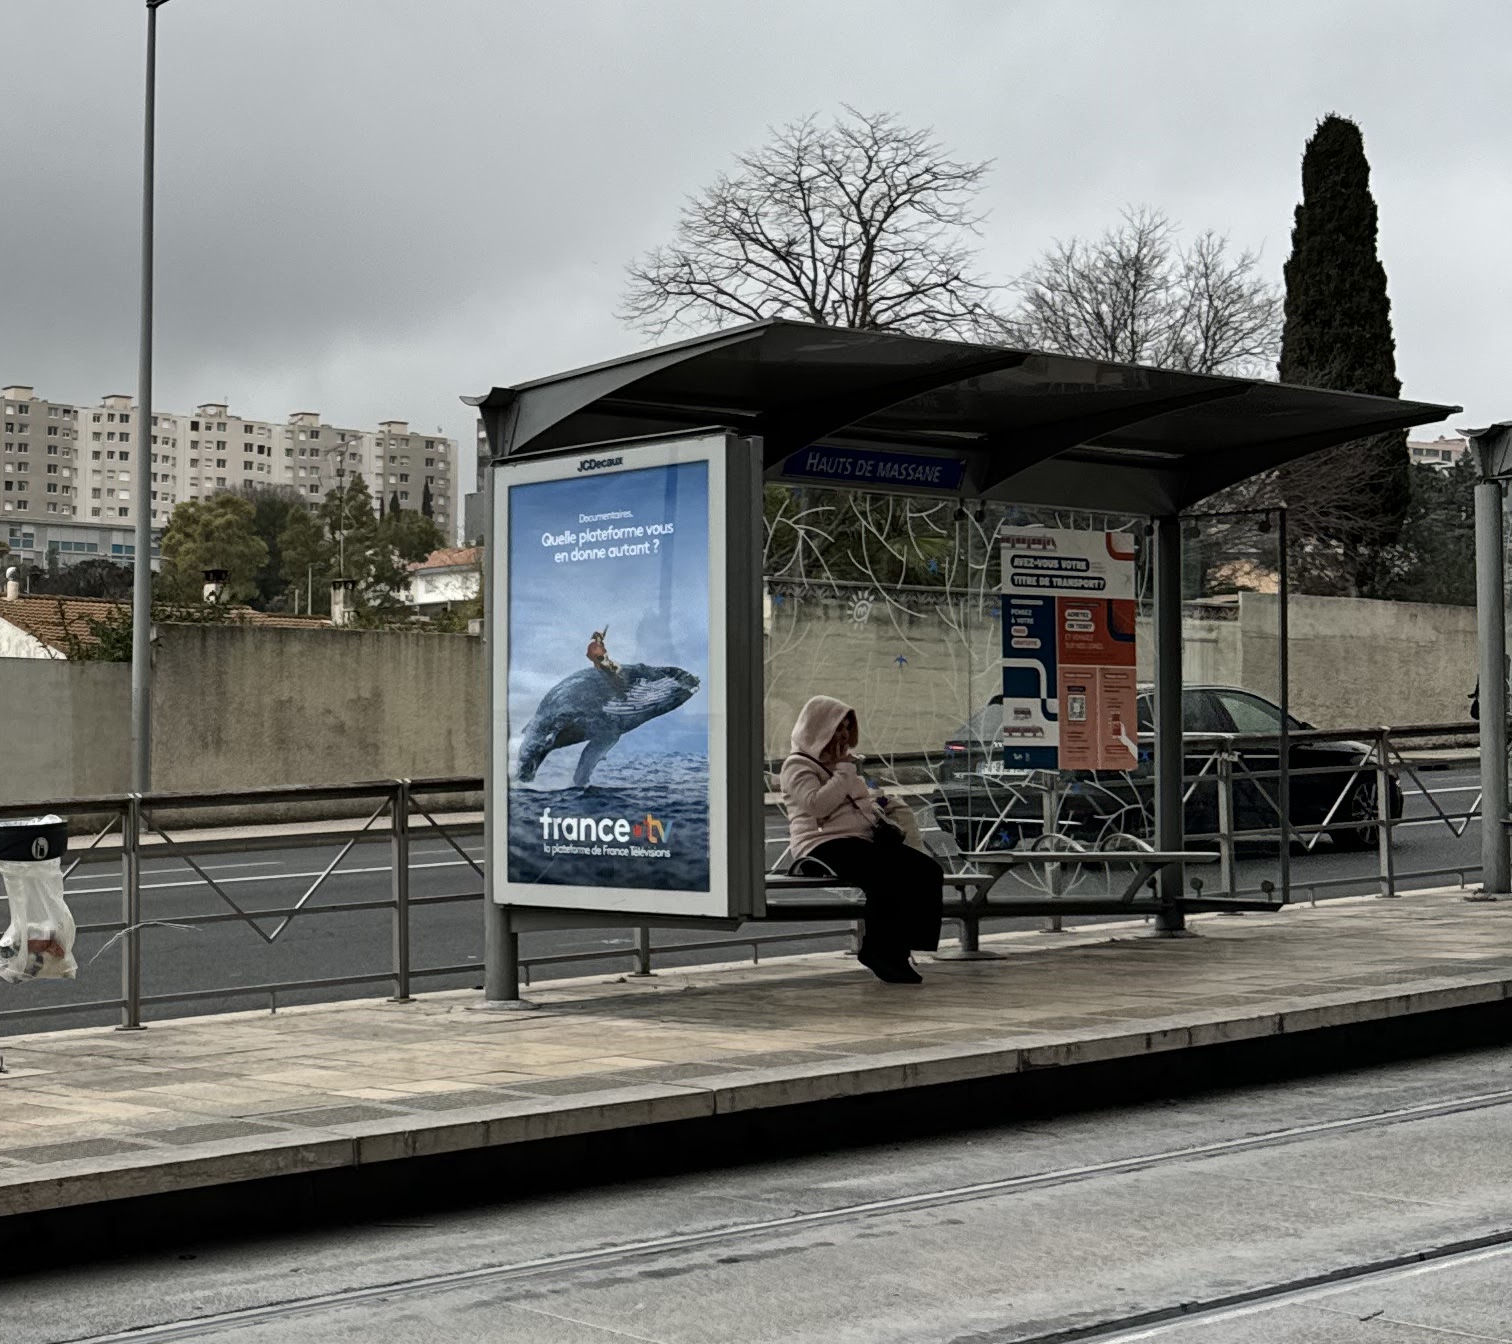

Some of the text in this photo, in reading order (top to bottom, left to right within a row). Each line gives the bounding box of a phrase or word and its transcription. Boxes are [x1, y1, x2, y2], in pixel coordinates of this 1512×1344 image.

[577, 457, 624, 472] JCDecaux
[805, 451, 942, 483] HAUTS DE MASSANE
[541, 523, 674, 547] Quelle plateforme vous
[554, 539, 660, 563] en donne autant ?
[1013, 557, 1059, 569] AVEZ-VOUS
[1060, 560, 1087, 570] VOTRE
[1013, 575, 1037, 586] TITRE
[1039, 577, 1050, 586] DE
[543, 843, 671, 858] la plateforme de France Télévisions
